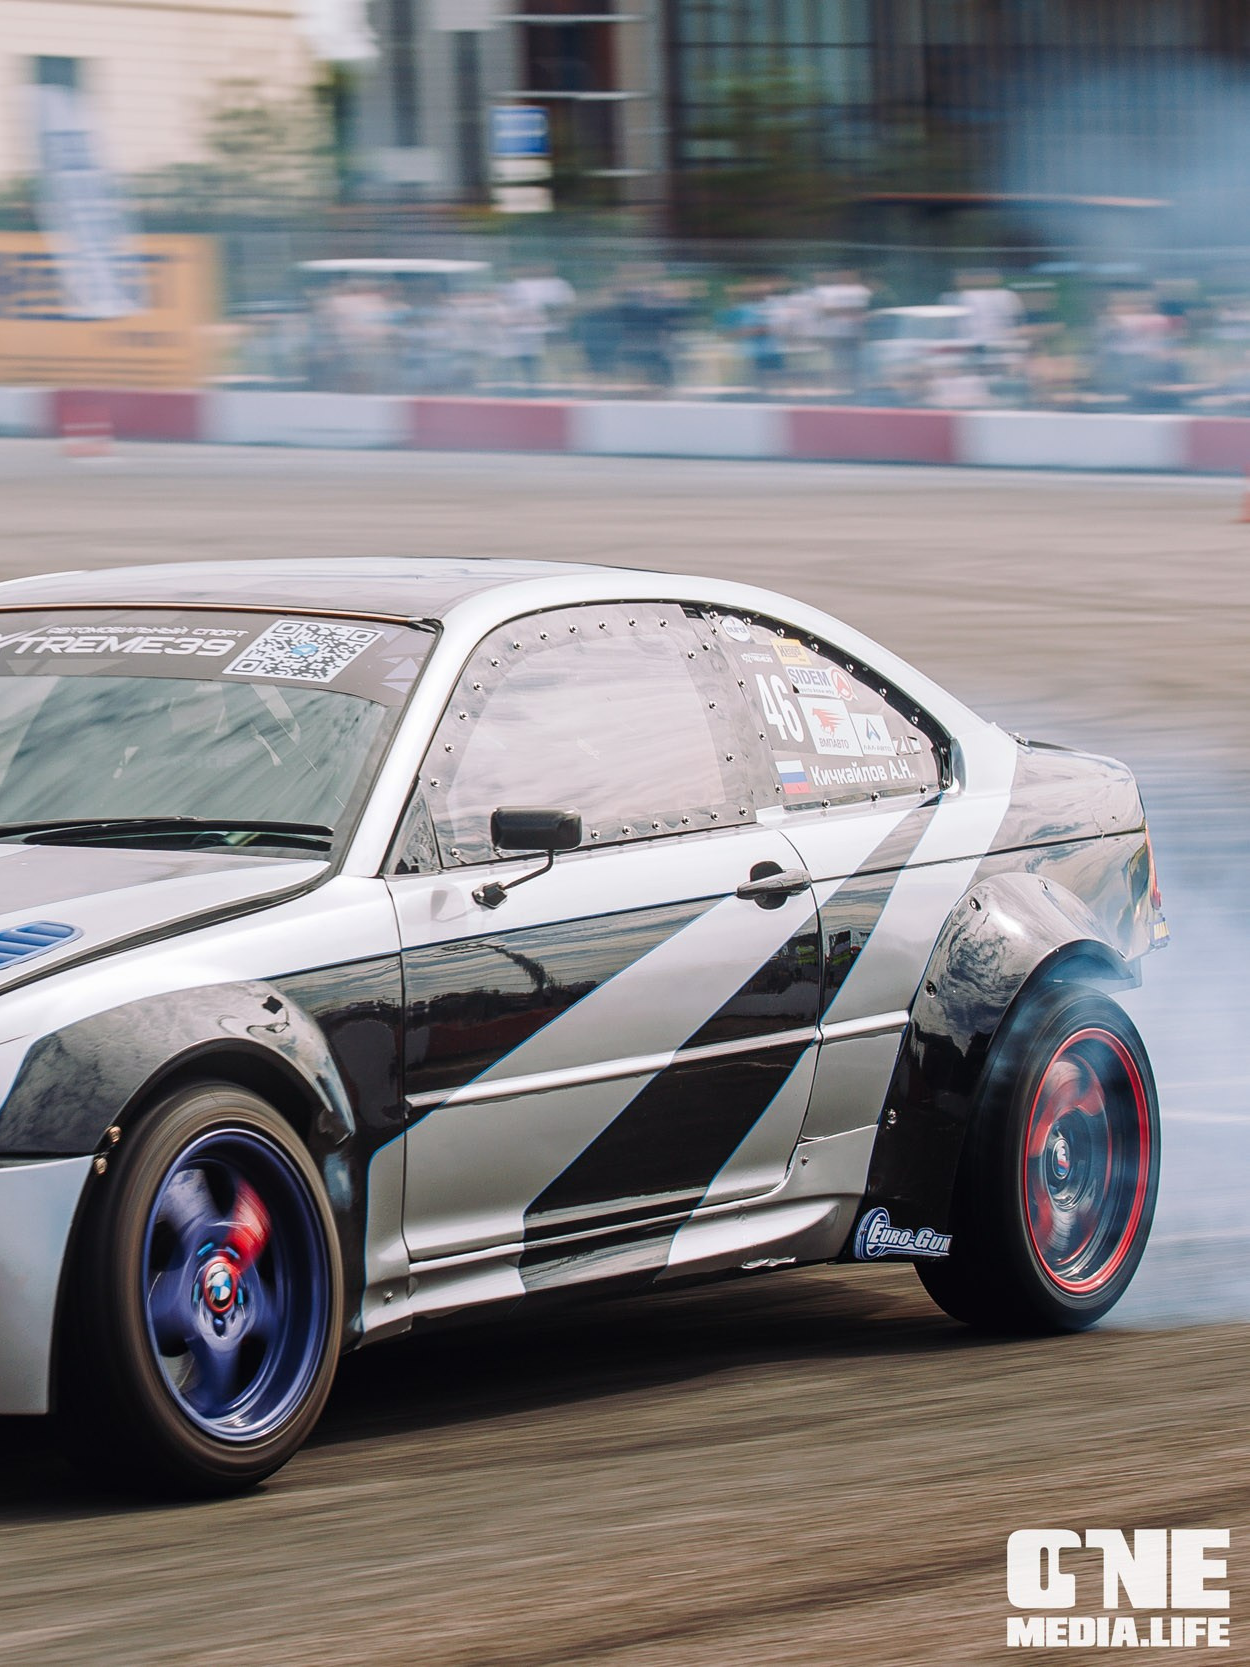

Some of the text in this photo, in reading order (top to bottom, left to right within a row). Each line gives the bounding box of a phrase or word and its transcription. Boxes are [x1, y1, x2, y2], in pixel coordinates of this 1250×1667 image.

[46, 625, 250, 638] АВТОМОБИЛЬНЫЙ СПОРТ
[787, 668, 832, 687] SIDEM
[754, 673, 805, 743] 46
[819, 737, 850, 750] ВМПАВТО
[810, 759, 916, 786] Кичкайлов А.Н.
